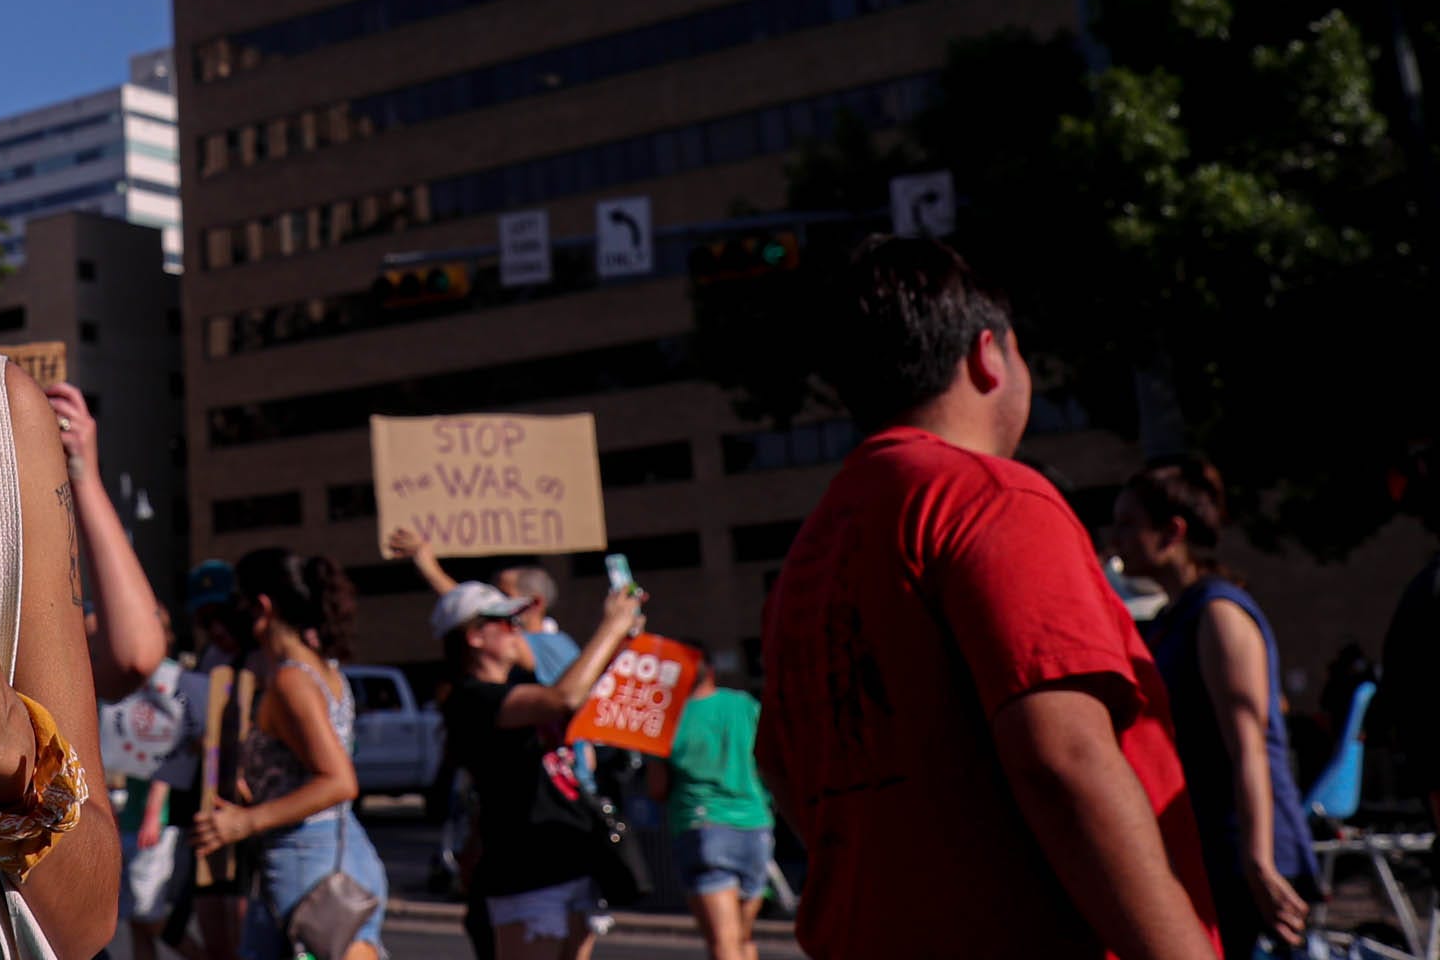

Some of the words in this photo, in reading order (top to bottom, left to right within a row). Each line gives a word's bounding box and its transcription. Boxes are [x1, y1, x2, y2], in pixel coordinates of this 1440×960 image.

[433, 420, 526, 457] STOP
[434, 462, 532, 500] WAR
[594, 700, 666, 738] BANS
